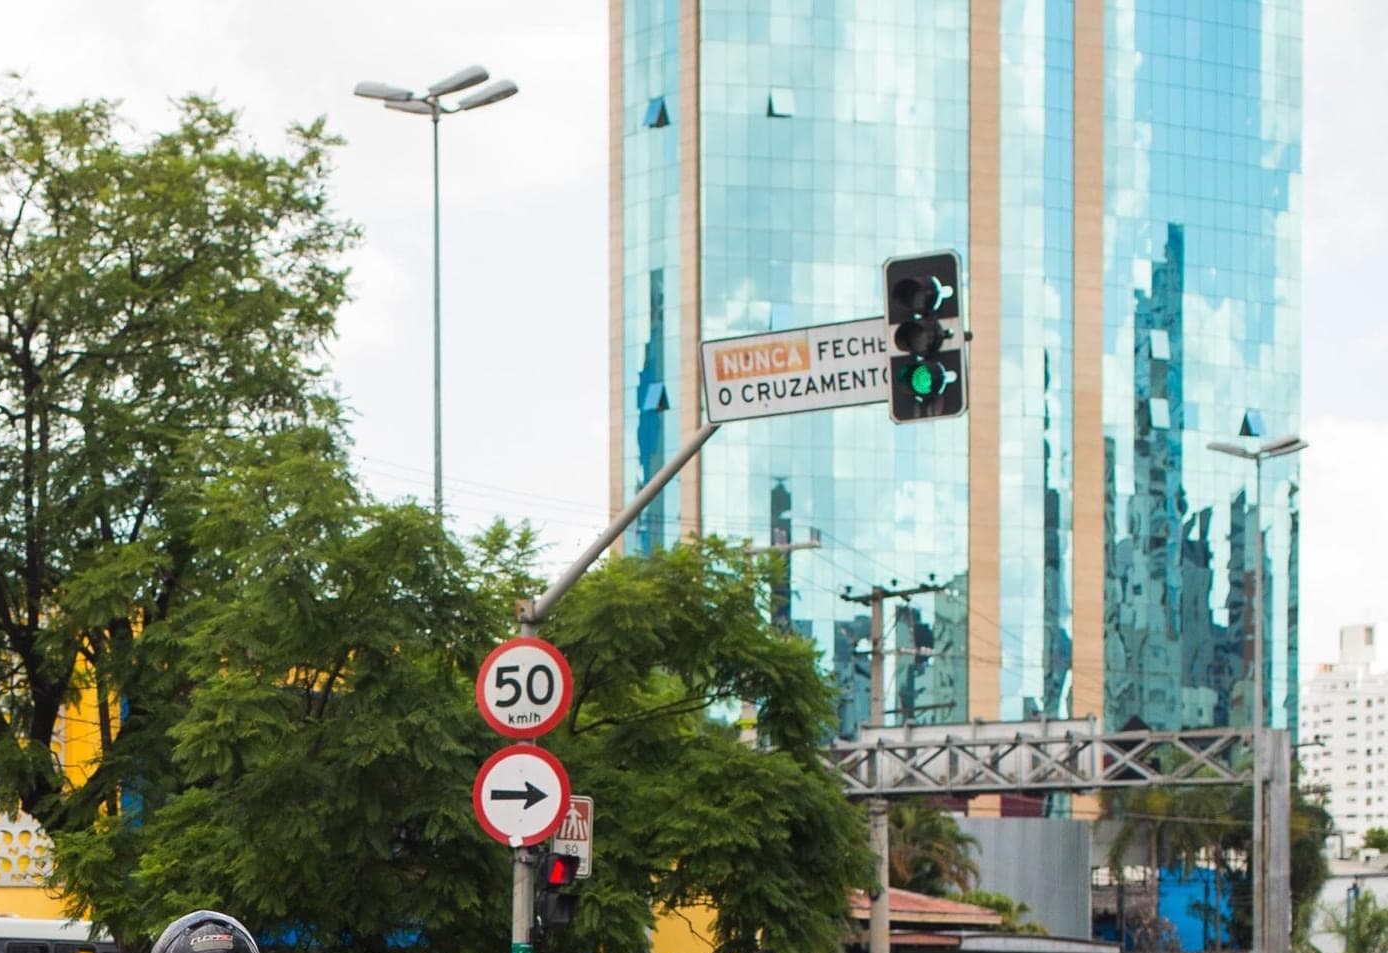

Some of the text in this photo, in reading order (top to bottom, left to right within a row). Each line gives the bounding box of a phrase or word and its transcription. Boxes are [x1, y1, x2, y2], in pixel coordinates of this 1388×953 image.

[722, 344, 804, 376] NUNCA
[718, 366, 888, 406] O CRUZAMENT
[494, 664, 555, 708] 50
[508, 712, 541, 725] km/h
